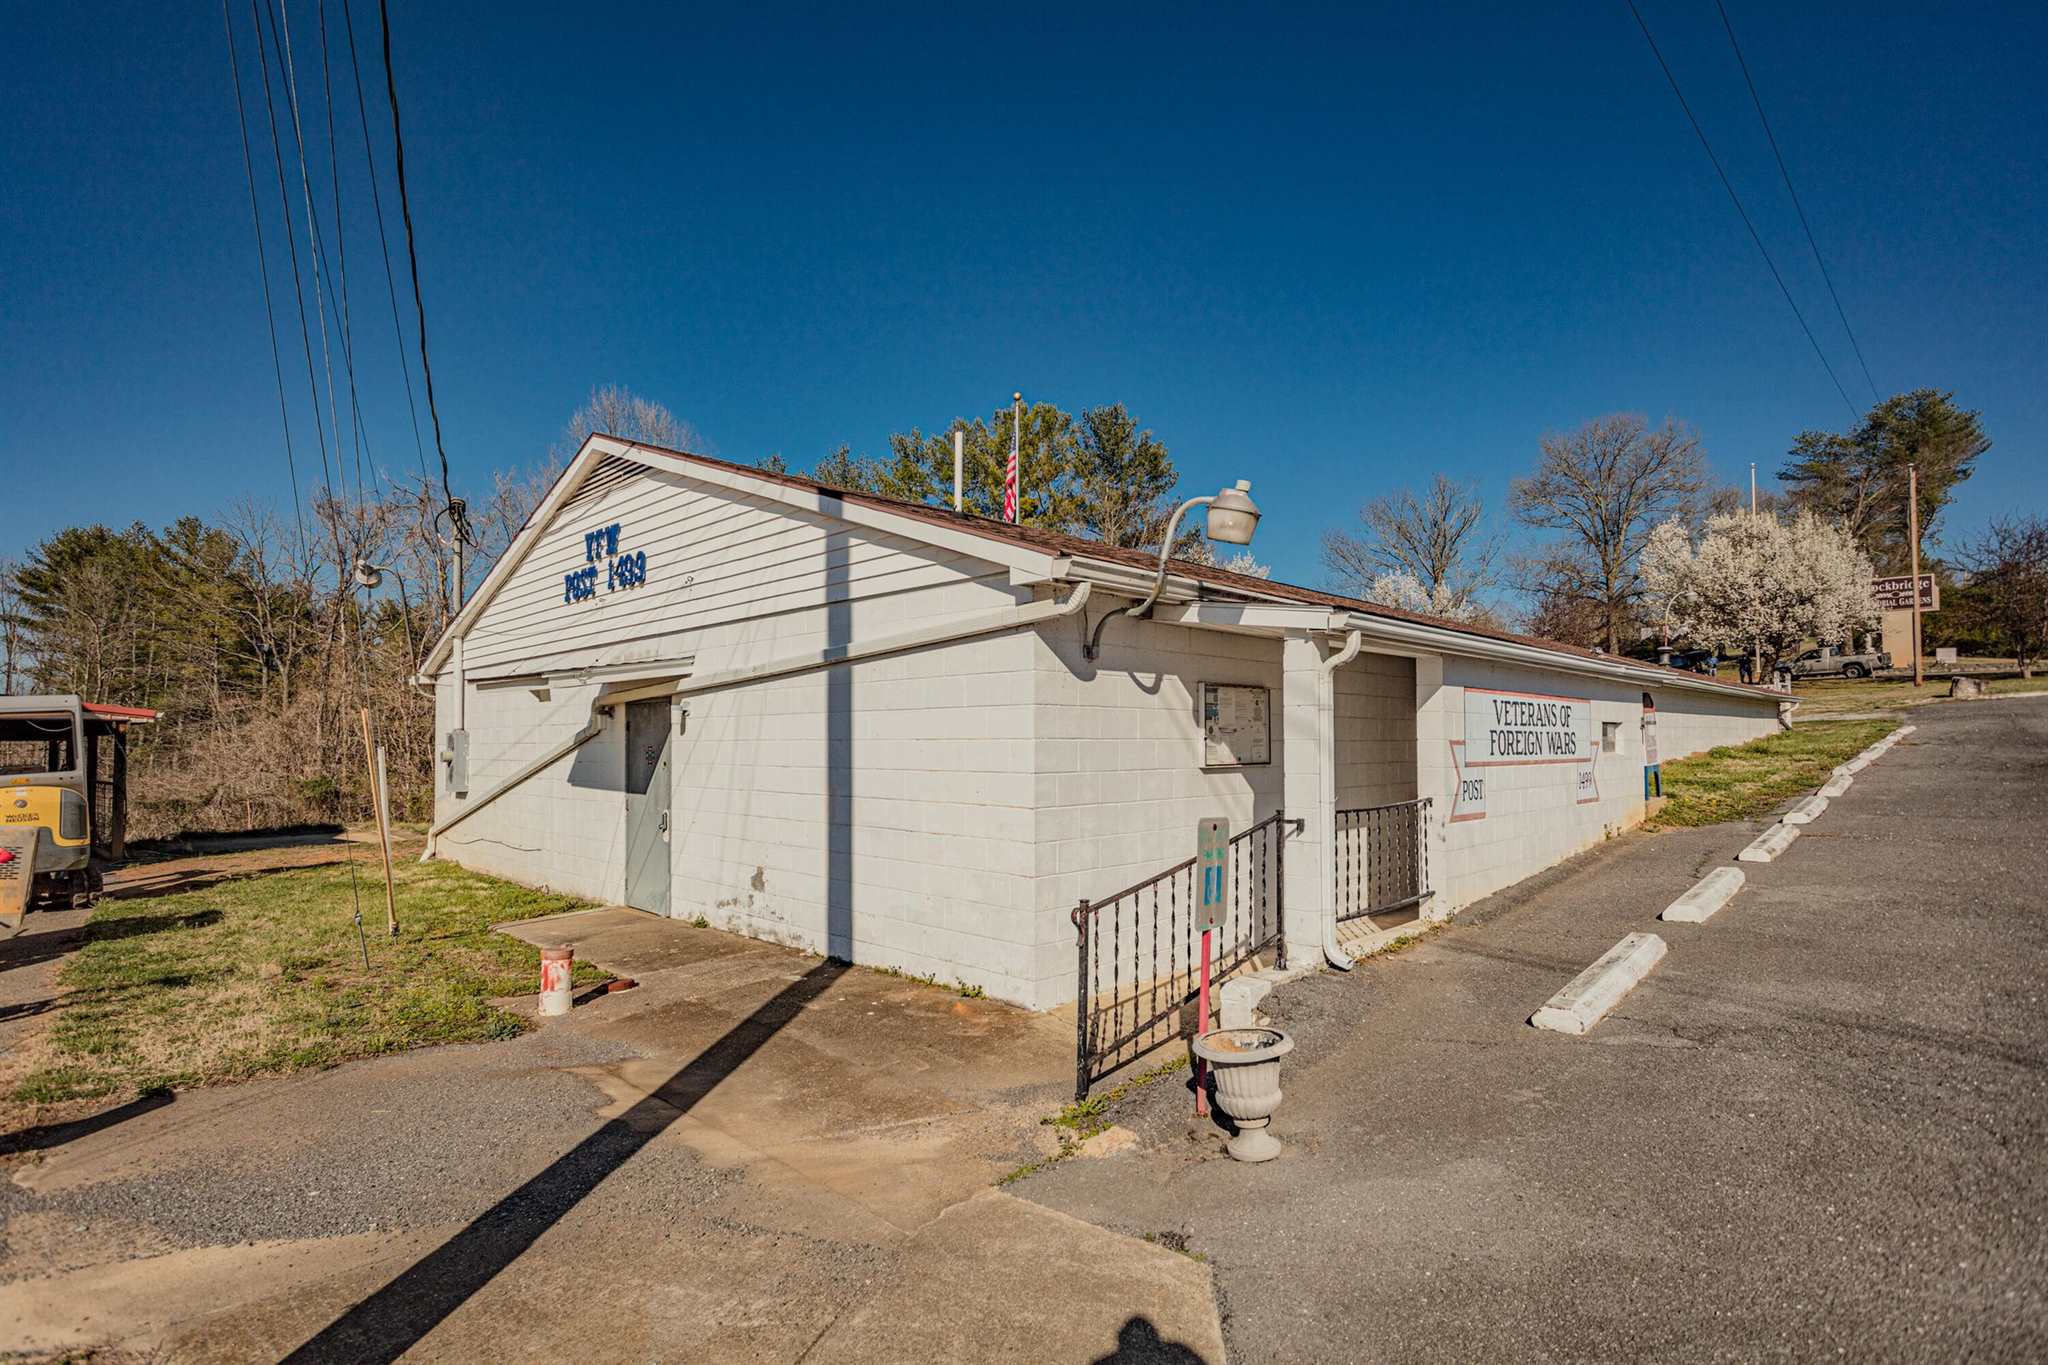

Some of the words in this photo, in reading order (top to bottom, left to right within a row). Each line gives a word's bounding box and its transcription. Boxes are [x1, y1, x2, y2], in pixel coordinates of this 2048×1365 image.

[564, 565, 598, 603] POST
[1492, 699, 1558, 727] VETERANS
[1559, 705, 1572, 728] OF
[1489, 729, 1543, 756] FOREIGN
[1546, 731, 1577, 756] WARS
[1462, 779, 1484, 802] POST
